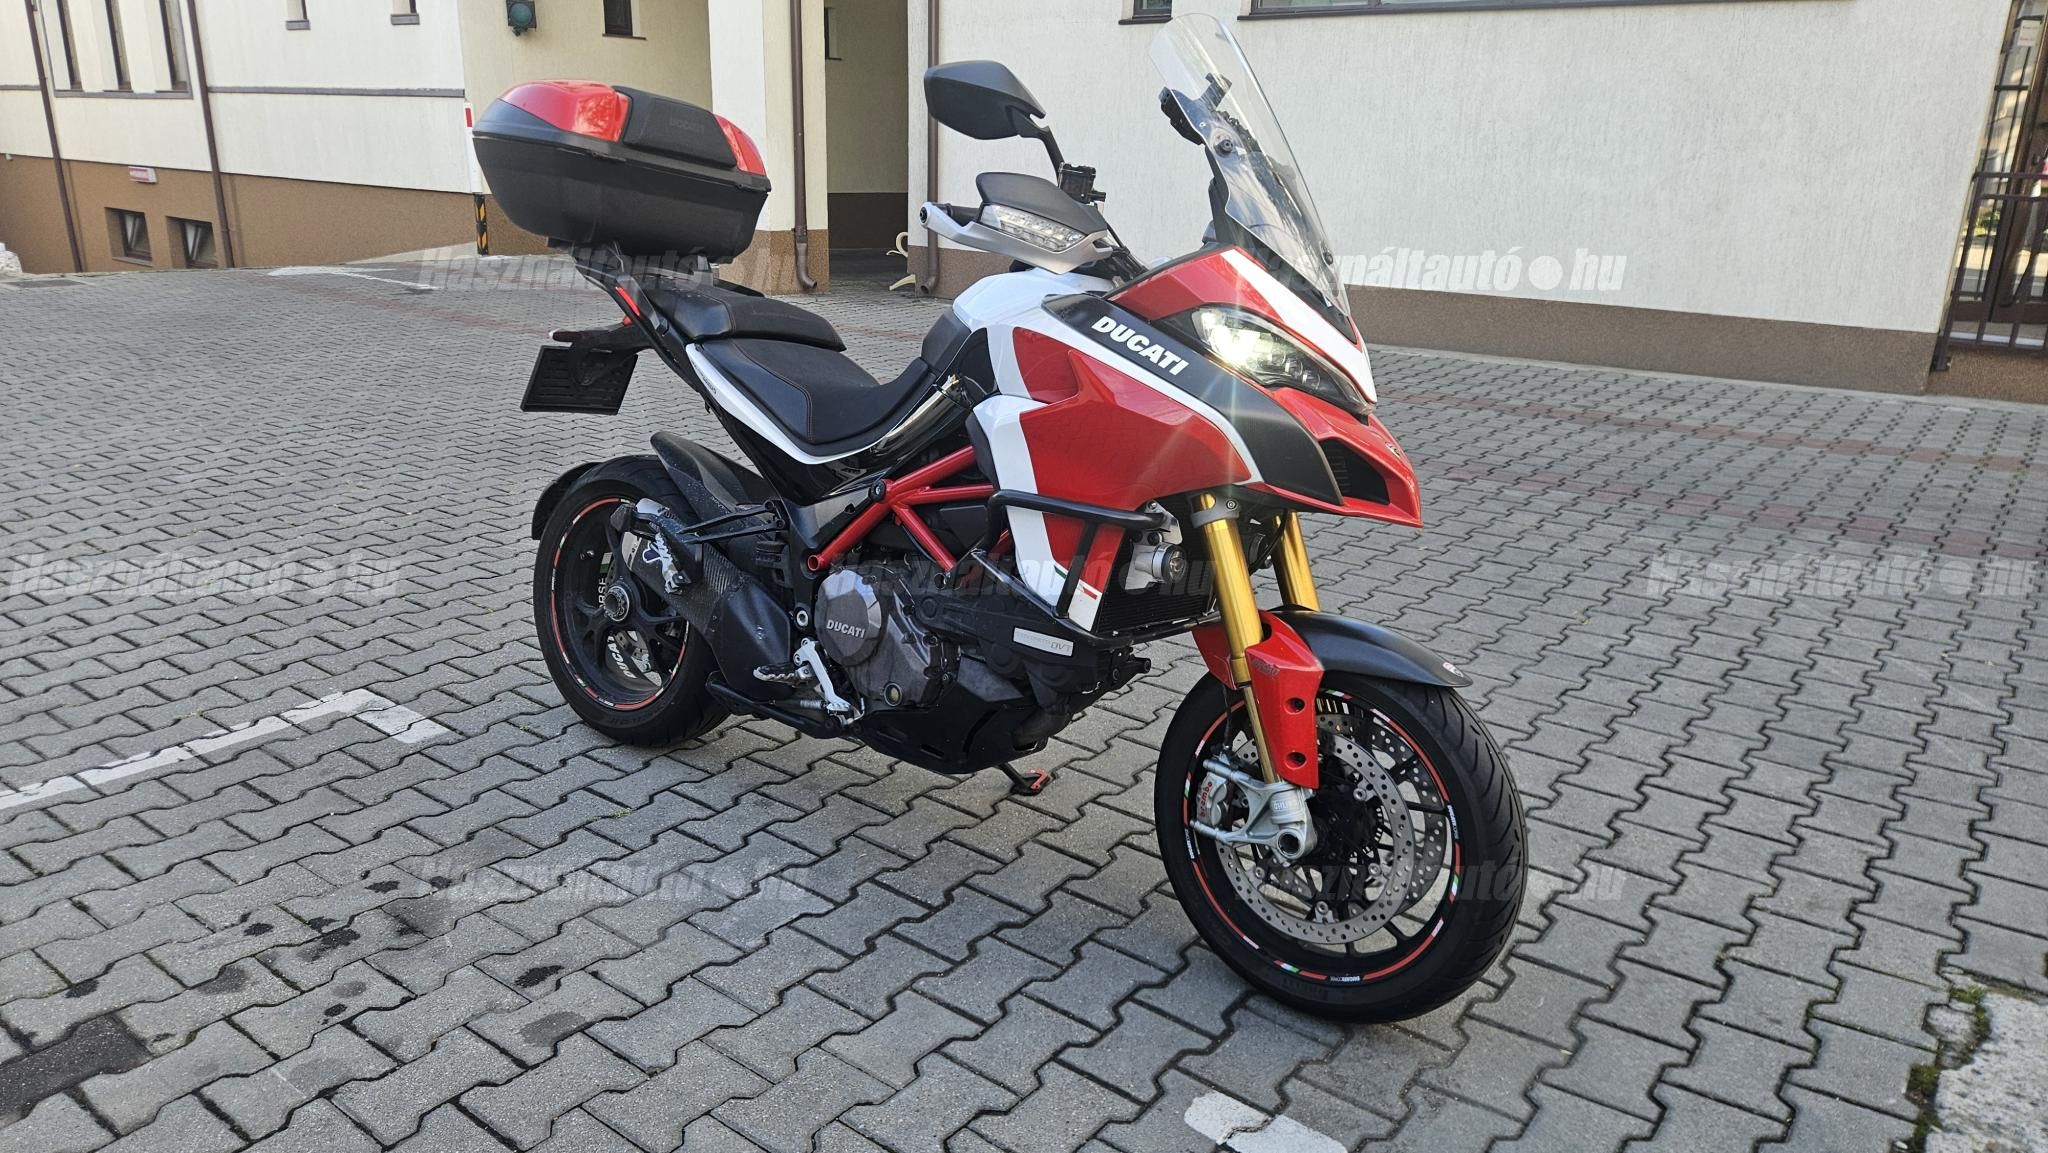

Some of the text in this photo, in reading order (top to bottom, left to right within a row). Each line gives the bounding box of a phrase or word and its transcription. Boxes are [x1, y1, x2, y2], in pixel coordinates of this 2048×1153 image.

[1091, 316, 1189, 376] DUCATI
[826, 619, 866, 639] DUCATI
[607, 634, 637, 679] DUCAT
[1200, 781, 1213, 817] brembo
